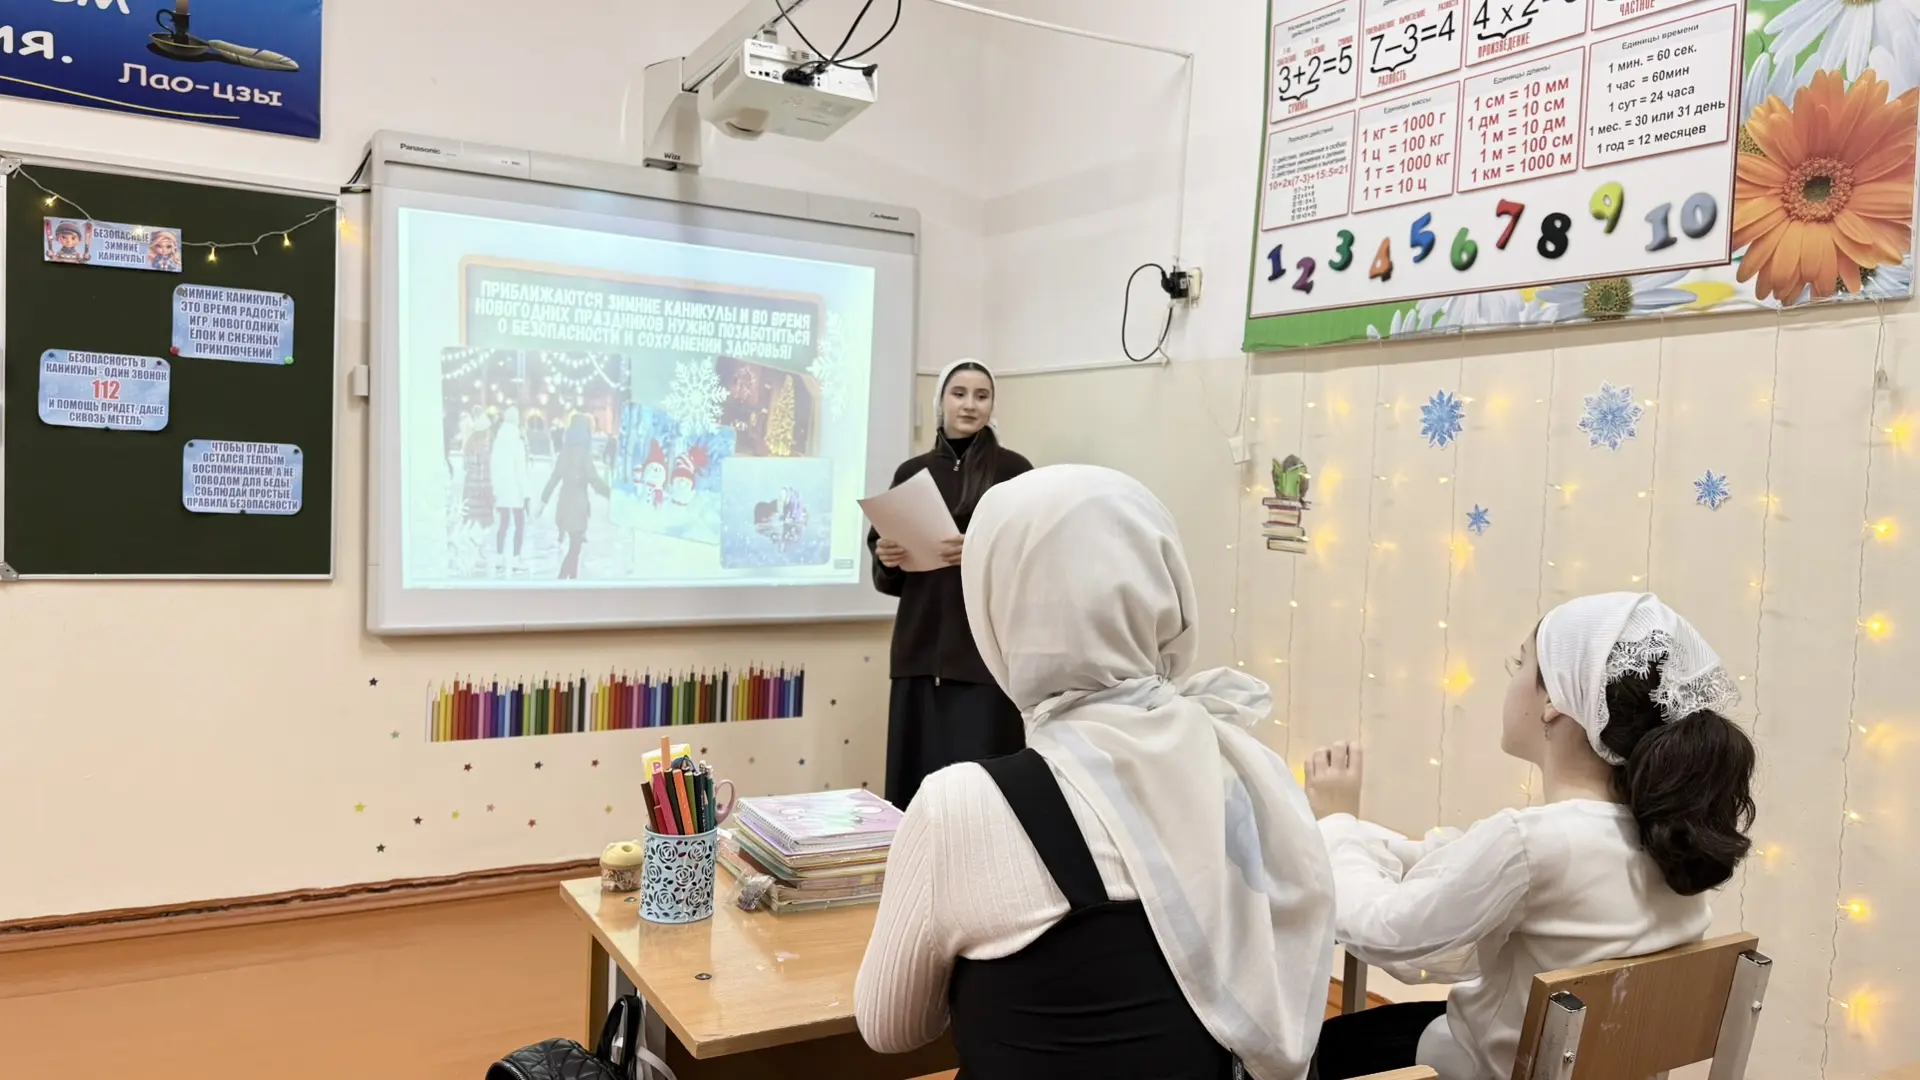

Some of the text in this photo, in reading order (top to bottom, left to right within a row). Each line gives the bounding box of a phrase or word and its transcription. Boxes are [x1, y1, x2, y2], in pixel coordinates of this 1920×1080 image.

[1621, 24, 1699, 50] Единицы времени
[1278, 45, 1353, 94] 3+2=5
[1608, 44, 1697, 73] 1 мин. 60 сек.
[118, 63, 283, 107] Лао-цзы
[1474, 97, 1480, 111] 1
[1485, 94, 1505, 108] см
[1524, 81, 1541, 99] 10
[1545, 77, 1569, 94] мм
[1607, 83, 1612, 93] 1
[1616, 80, 1635, 91] час
[1609, 85, 1695, 113] 1 сут 24 часа
[1468, 116, 1474, 131] 1
[1478, 113, 1499, 131] дм
[1522, 100, 1539, 118] 10
[1544, 97, 1565, 112] см
[1589, 100, 1725, 136] 1 мес. 30 или 31 день
[1362, 129, 1368, 143] 1
[1373, 127, 1386, 141] кг
[1402, 111, 1435, 133] 1000
[1440, 112, 1446, 124] г
[1481, 130, 1486, 145] 1
[1492, 130, 1504, 143] м
[1522, 119, 1539, 136] 10
[1542, 115, 1566, 134] дм
[400, 142, 441, 155] Panasonic
[1362, 148, 1367, 163] 1
[1372, 148, 1381, 162] ц
[1402, 134, 1425, 153] 100
[1430, 133, 1444, 147] кг
[1480, 148, 1486, 163] 1
[1492, 148, 1503, 161] м
[1521, 135, 1547, 155] 100
[1552, 133, 1574, 148] см
[1597, 144, 1602, 154] 1
[1605, 141, 1624, 153] год
[1638, 134, 1651, 145] 12
[1654, 124, 1706, 142] месяцев
[1365, 167, 1370, 181] 1
[1375, 167, 1383, 179] т
[1399, 153, 1431, 174] 1000
[1436, 152, 1451, 166] кг
[1471, 168, 1477, 183] 1
[1483, 167, 1501, 181] км
[1520, 152, 1555, 173] 1000
[1560, 152, 1572, 166] м
[1363, 186, 1369, 200] 1
[1374, 187, 1381, 198] т
[1398, 177, 1413, 194] 10
[1418, 178, 1427, 191] ц
[104, 241, 138, 252] ЗИМНИЕ
[1267, 181, 1718, 294] 1 2 3 4 5 6 7 8 9 10
[98, 252, 145, 263] КАНИКУЛЫ
[181, 301, 201, 313] ЭТО
[203, 303, 237, 316] ВРЕМЯ
[226, 291, 282, 307] КАНИКУЛЫ
[481, 279, 811, 329] ПРИБЛИЖАЮТСЯ ЗИМНИЕ КАНИКУЛЫ И ВО ВРЕМЯ
[212, 318, 279, 333] НОВОГОДНИХ
[475, 297, 810, 346] НОВОГОДНИХ ПРАЗДНИКОВ НУЖНО ПОЗАБОТИТЬСЯ
[218, 330, 225, 341] И
[227, 332, 278, 346] СНЕЖНЫХ
[497, 318, 507, 334] О
[512, 319, 620, 346] БЕЗОПАСНОСТИ
[624, 329, 634, 346] И
[637, 332, 722, 354] СОХРАНЕНИИ
[68, 352, 147, 368] БЕЗОПАСНОСТЬ В
[46, 363, 167, 381] КАНИКУЛЫ ОДИН ЗВОНОК
[92, 379, 121, 400] 112
[49, 399, 55, 408] И
[57, 399, 98, 412] ПОМОЩЬ
[139, 405, 164, 416] ДАЖЕ
[69, 412, 142, 425] СКВОЗЬ МЕТЕЛЬ
[203, 453, 244, 464] ОСТАЛСЯ
[212, 442, 279, 454] ЧТОБЫ ОТДЫХ
[195, 475, 240, 486] ПОВОДОМ
[241, 477, 261, 486] ДЛЯ
[276, 468, 282, 476] А
[284, 468, 294, 476] НЕ
[186, 498, 298, 510] ПРАВИЛА БЕЗОПАСНОСТИ
[195, 486, 290, 499] СОБЛЮДАЙ ПРОСТЫЕ
